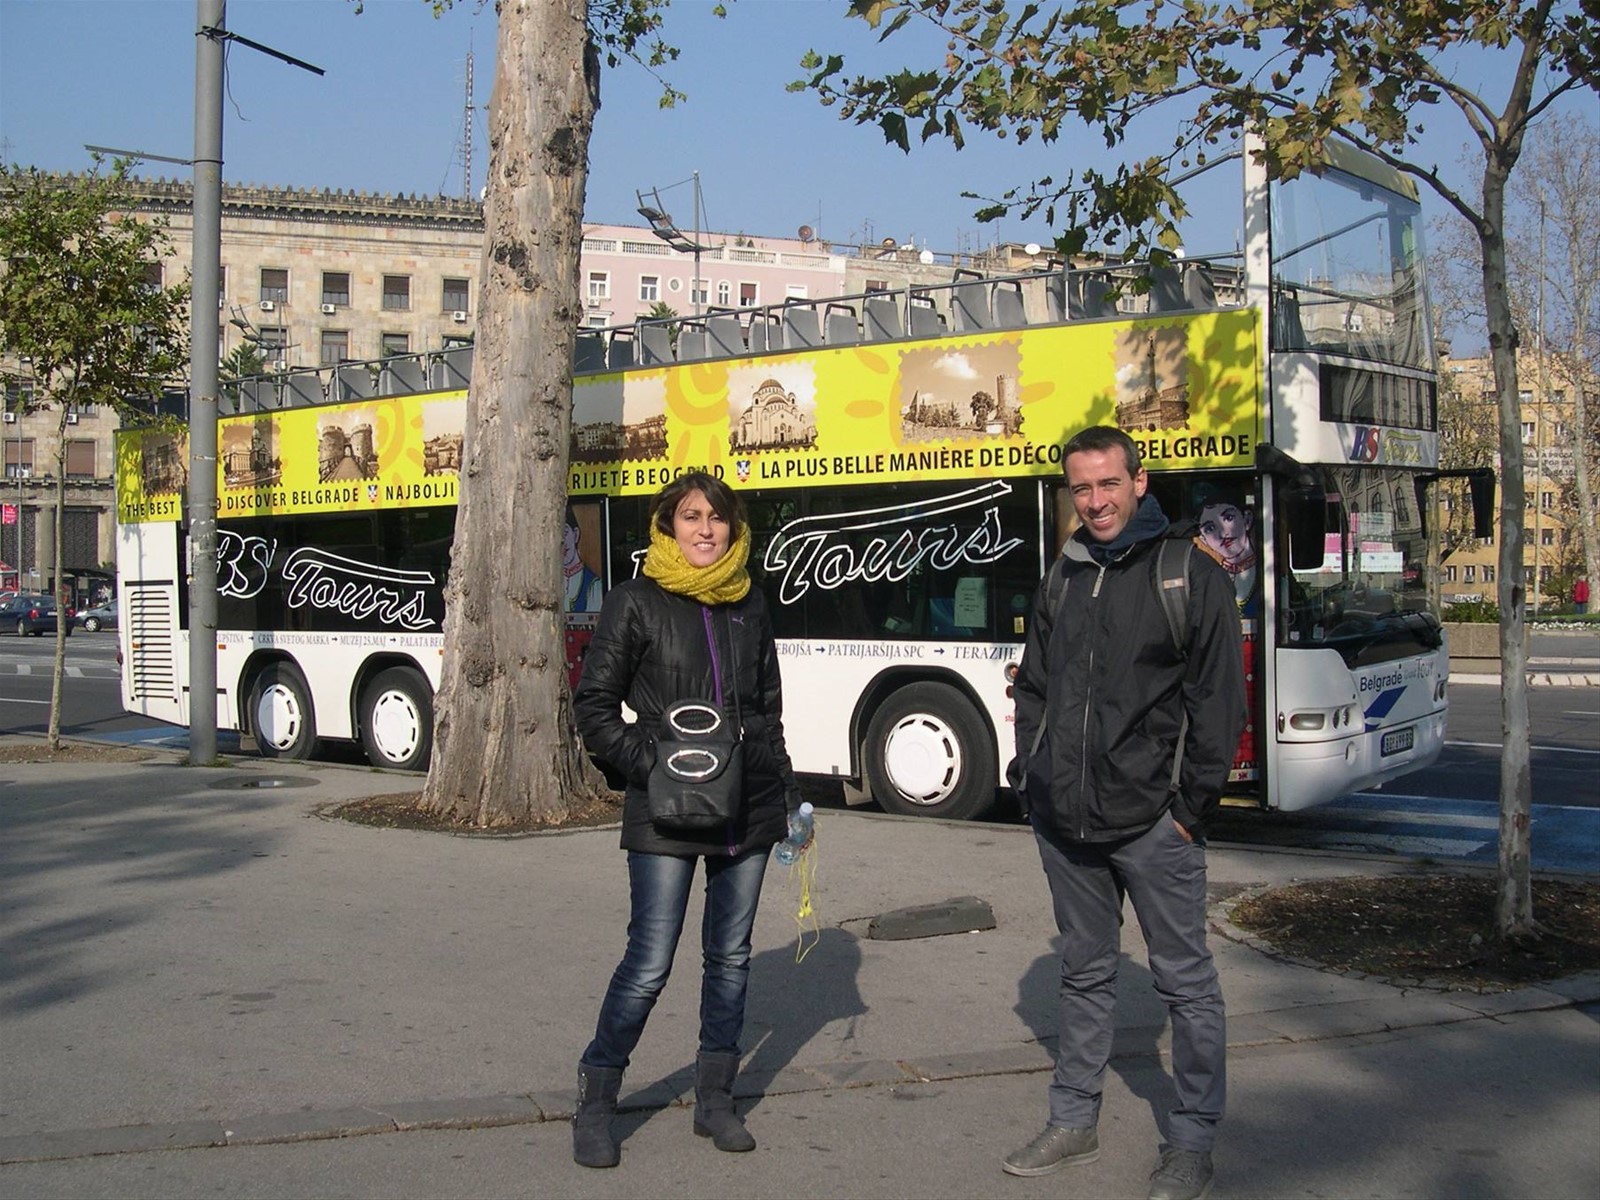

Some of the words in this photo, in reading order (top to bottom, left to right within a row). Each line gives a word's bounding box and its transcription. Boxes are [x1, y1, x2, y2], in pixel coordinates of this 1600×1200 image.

[761, 461, 781, 479] LA
[786, 457, 828, 477] PLUS
[833, 454, 885, 474] BELLE
[889, 446, 974, 472] MANIÈRE
[980, 447, 1005, 467] DE
[1009, 442, 1066, 466] DÉCO
[1136, 434, 1249, 460] BELGRADE
[1349, 426, 1381, 463] BS
[385, 482, 455, 500] NAJBOLJI
[567, 469, 629, 490] RIJETE
[126, 503, 145, 517] THE
[149, 501, 175, 515] BEST
[227, 492, 286, 510] DISCOVER
[292, 487, 359, 505] BELGRADE
[763, 479, 1025, 605] Tours
[282, 547, 436, 631] Tours
[776, 642, 812, 658] EBOJŠA
[828, 642, 901, 660] PATRIJARŠIJA
[903, 644, 925, 659] SPC
[953, 646, 1018, 662] TERAZIJE
[1360, 670, 1403, 692] Belgrade
